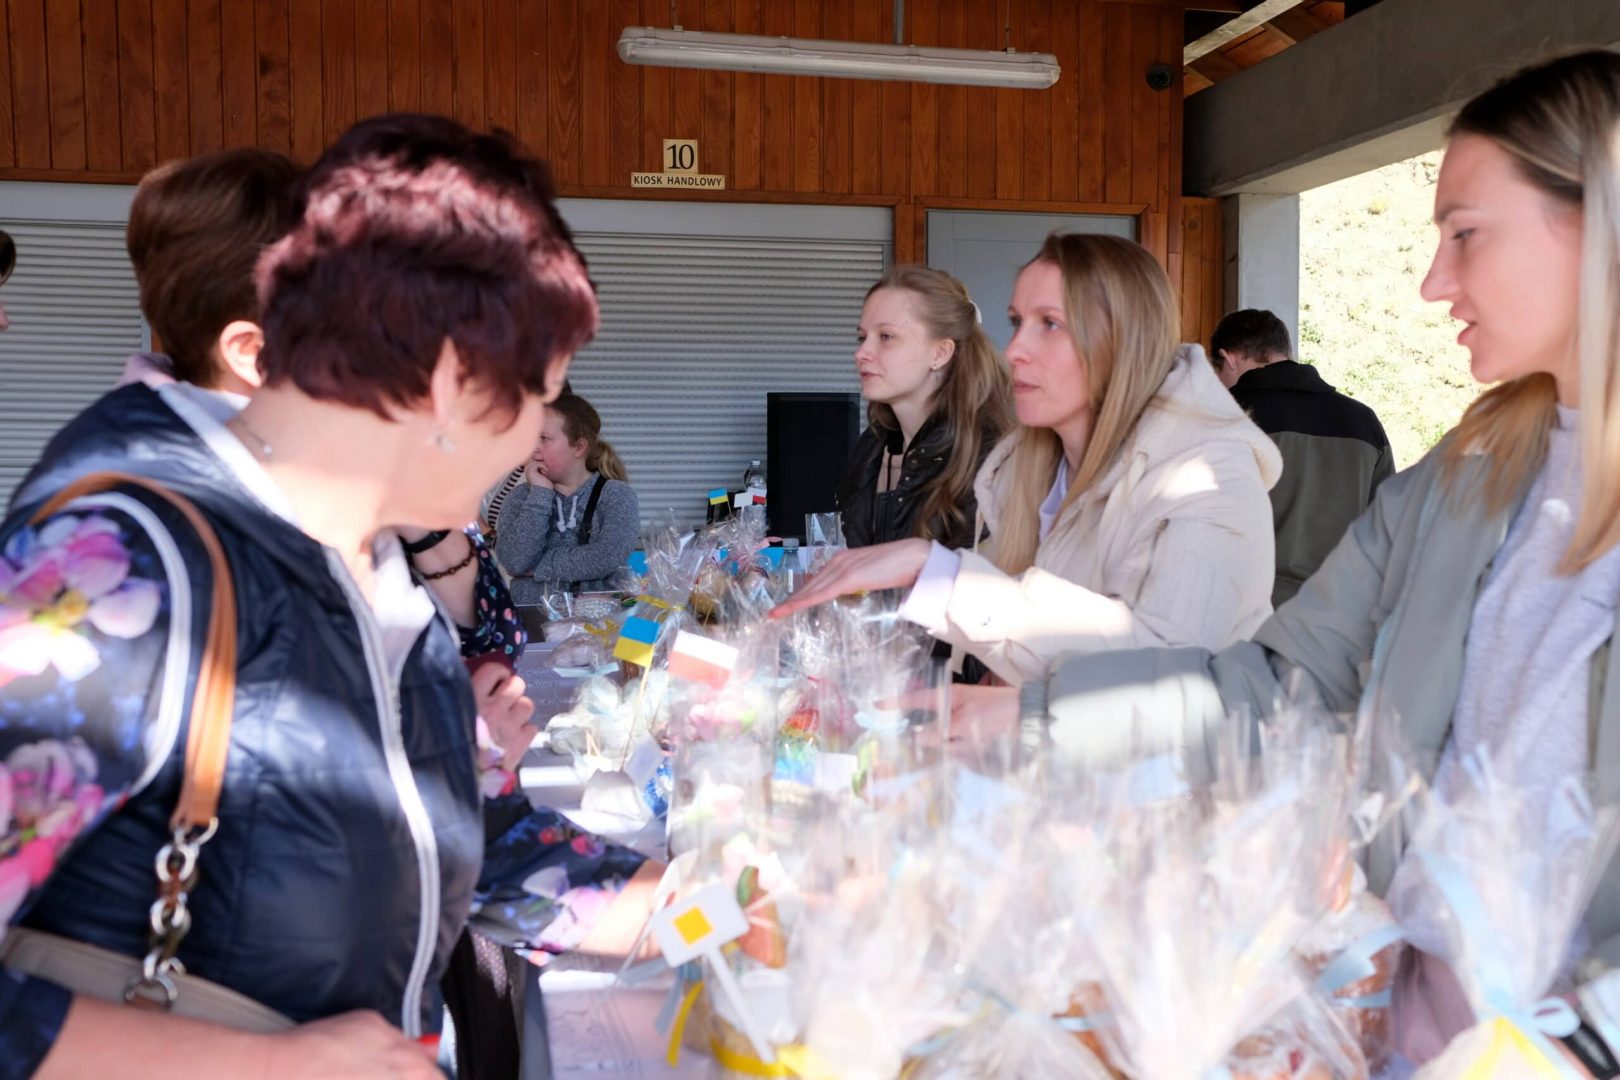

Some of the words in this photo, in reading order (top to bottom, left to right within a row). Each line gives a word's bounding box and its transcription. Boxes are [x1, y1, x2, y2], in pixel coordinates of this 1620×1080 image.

[666, 143, 695, 170] 10
[633, 175, 663, 185] KIOSK
[667, 176, 722, 187] HANDLOWY
